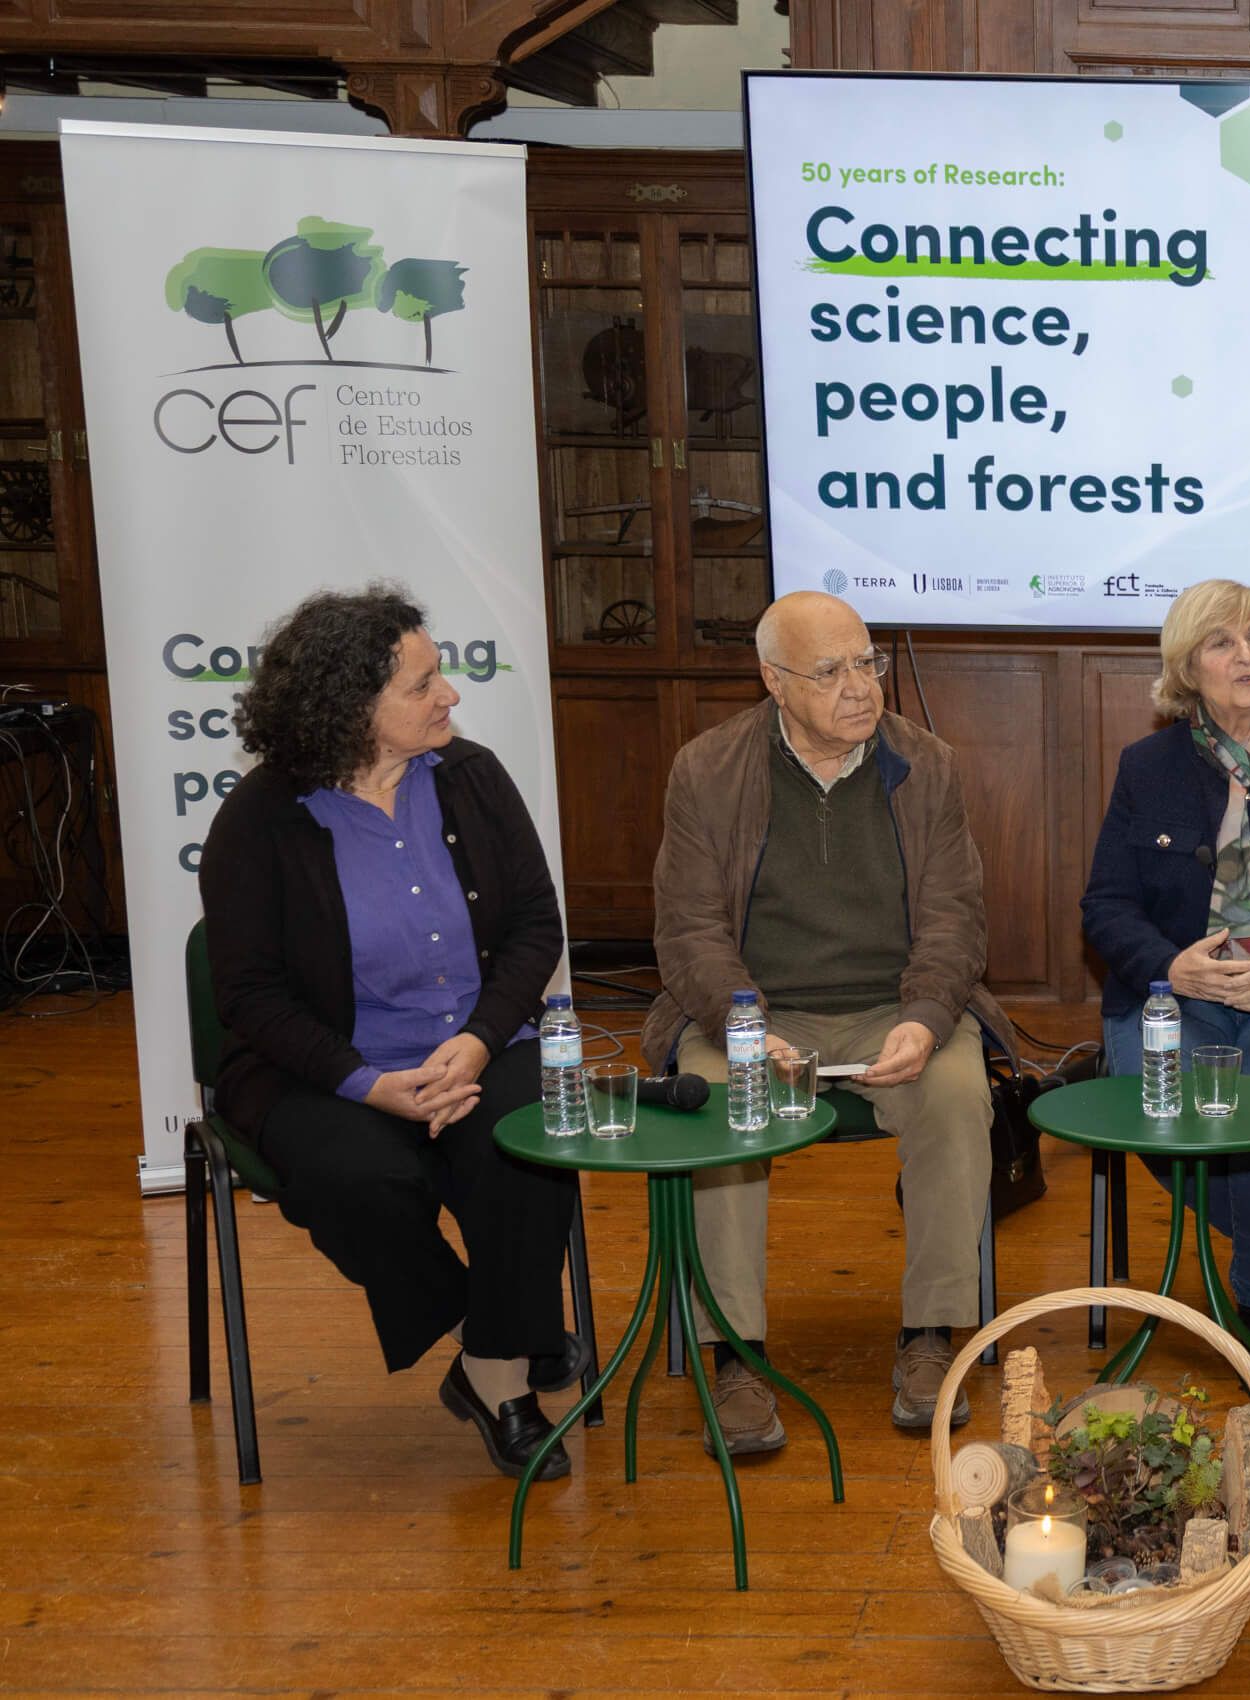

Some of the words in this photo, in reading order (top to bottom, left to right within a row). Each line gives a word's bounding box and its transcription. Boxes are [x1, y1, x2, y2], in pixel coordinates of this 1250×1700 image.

[801, 162, 832, 183] 50
[840, 166, 907, 188] years
[913, 163, 938, 184] of
[945, 164, 1066, 187] Research:
[806, 205, 1209, 287] Connecting
[809, 284, 1090, 356] science,
[336, 384, 421, 407] Centro
[815, 365, 1068, 440] people,
[153, 384, 317, 465] cef
[338, 414, 369, 437] de
[377, 415, 474, 438] Estudos
[340, 443, 463, 466] Florestais
[817, 453, 947, 511] and
[967, 454, 1206, 515] forests
[853, 576, 897, 588] TERRA
[932, 576, 964, 592] LISBOA
[1103, 572, 1140, 597] fct
